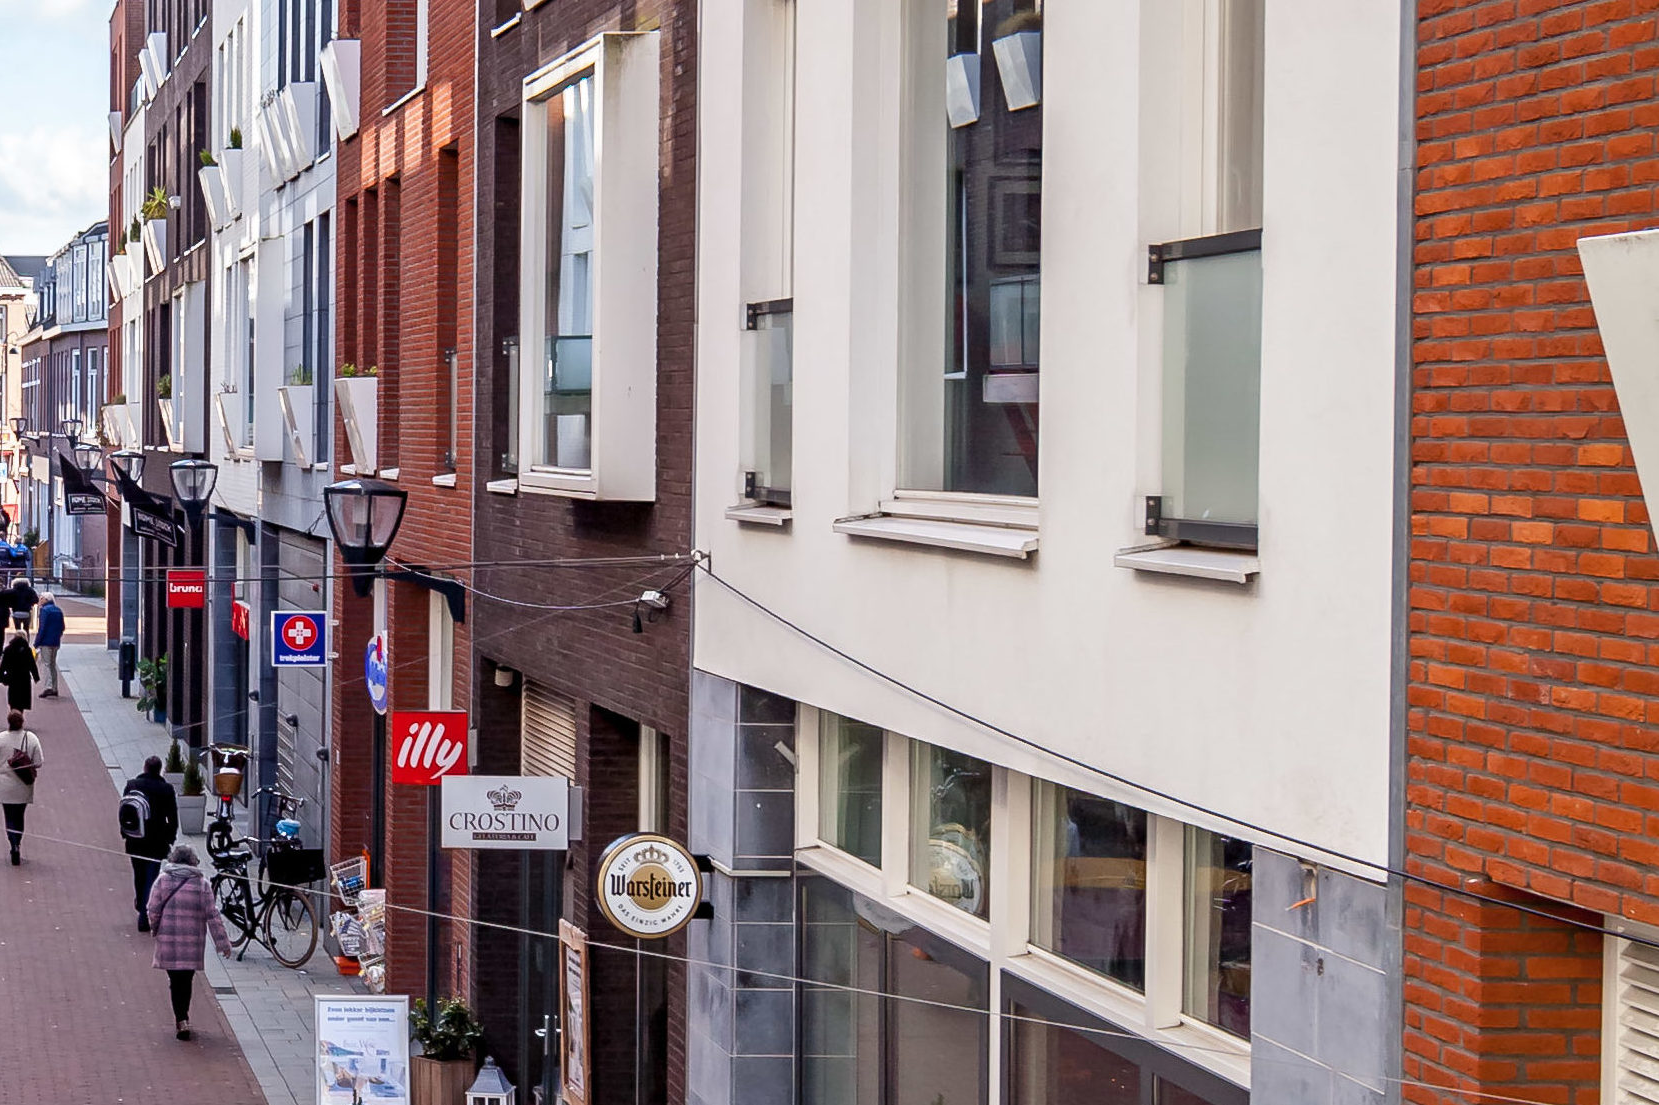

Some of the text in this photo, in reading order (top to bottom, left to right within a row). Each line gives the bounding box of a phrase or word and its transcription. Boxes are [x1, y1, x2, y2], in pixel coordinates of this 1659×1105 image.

[169, 583, 203, 593] bruna
[397, 721, 463, 780] illy
[449, 812, 560, 832] CROSTINO
[610, 873, 693, 900] Warsteiner
[617, 903, 629, 918] DAS
[630, 916, 658, 926] EINZIG
